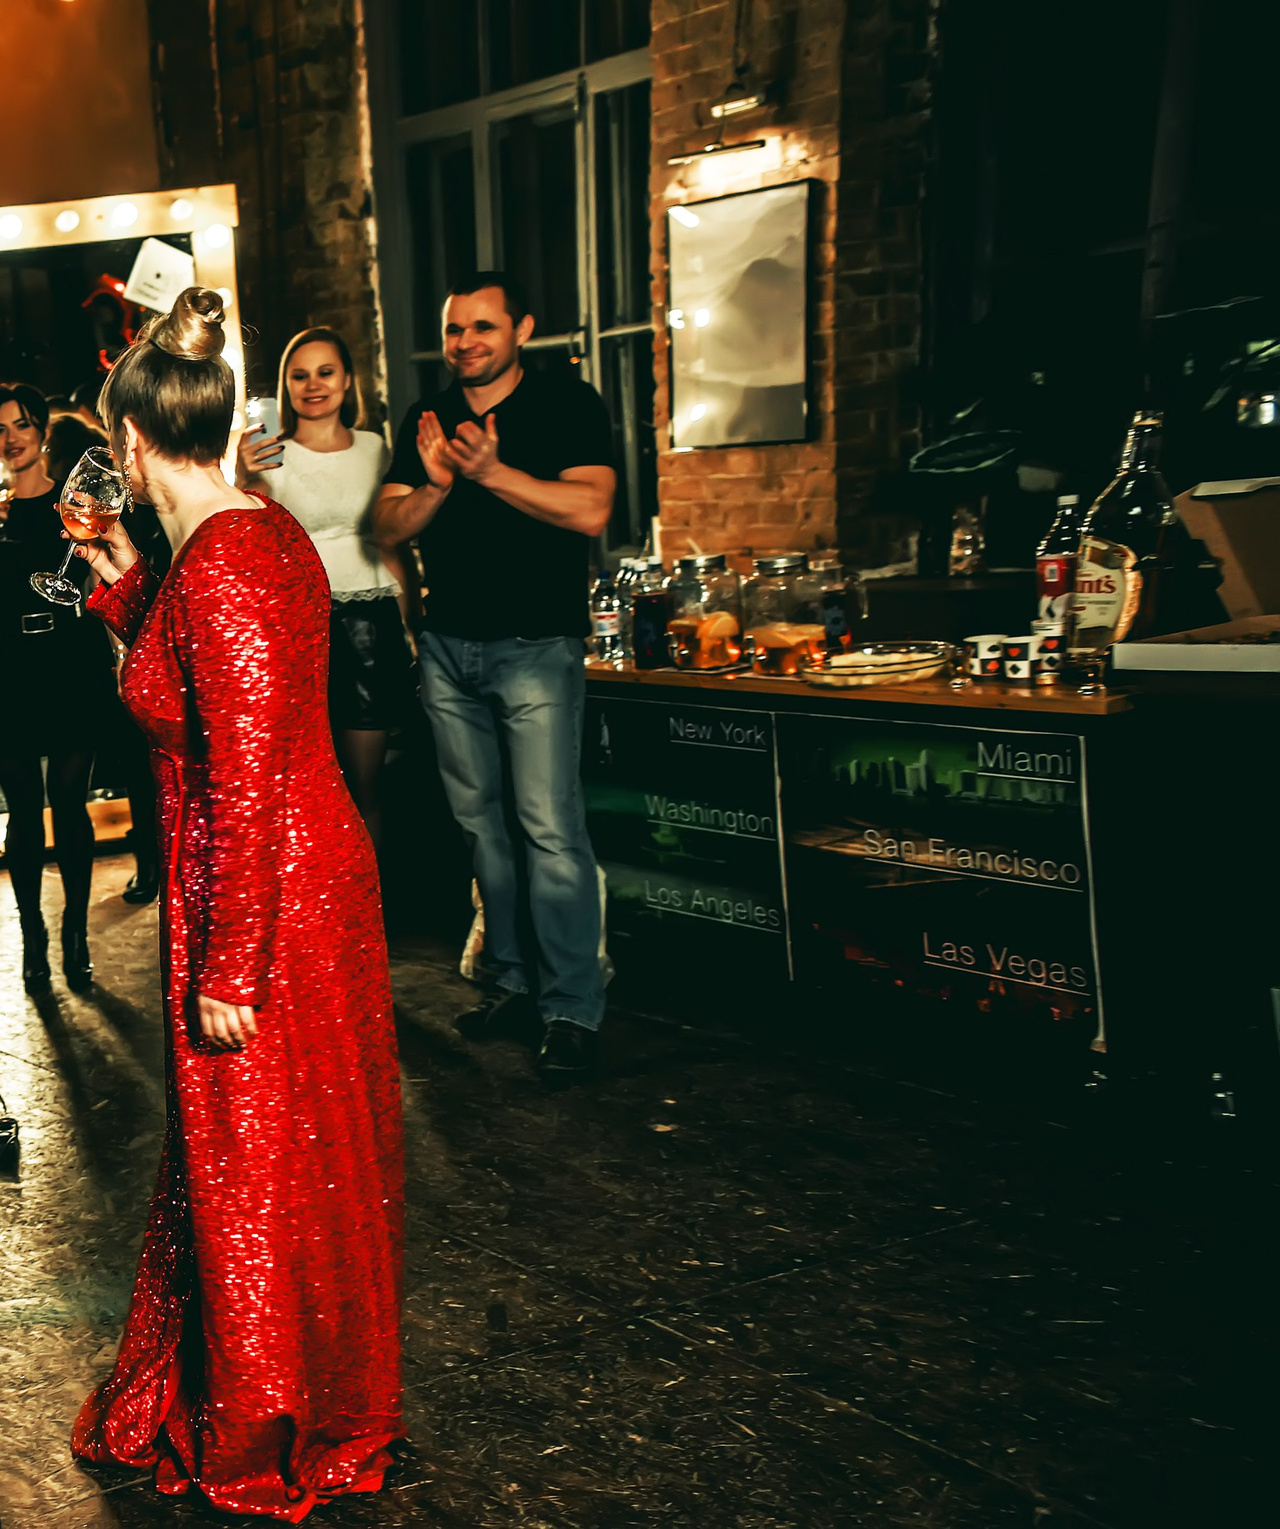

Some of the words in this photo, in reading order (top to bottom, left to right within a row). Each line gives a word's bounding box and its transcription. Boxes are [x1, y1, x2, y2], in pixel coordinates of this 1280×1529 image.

[668, 716, 713, 740] New
[719, 720, 767, 746] York
[976, 741, 1073, 776] Miami
[645, 795, 774, 834] Washington
[863, 828, 917, 860] San
[927, 837, 1081, 884] Francisco
[645, 879, 684, 907] Los
[690, 889, 781, 927] Angeles
[923, 931, 976, 966] Las
[985, 943, 1087, 988] Vegas
